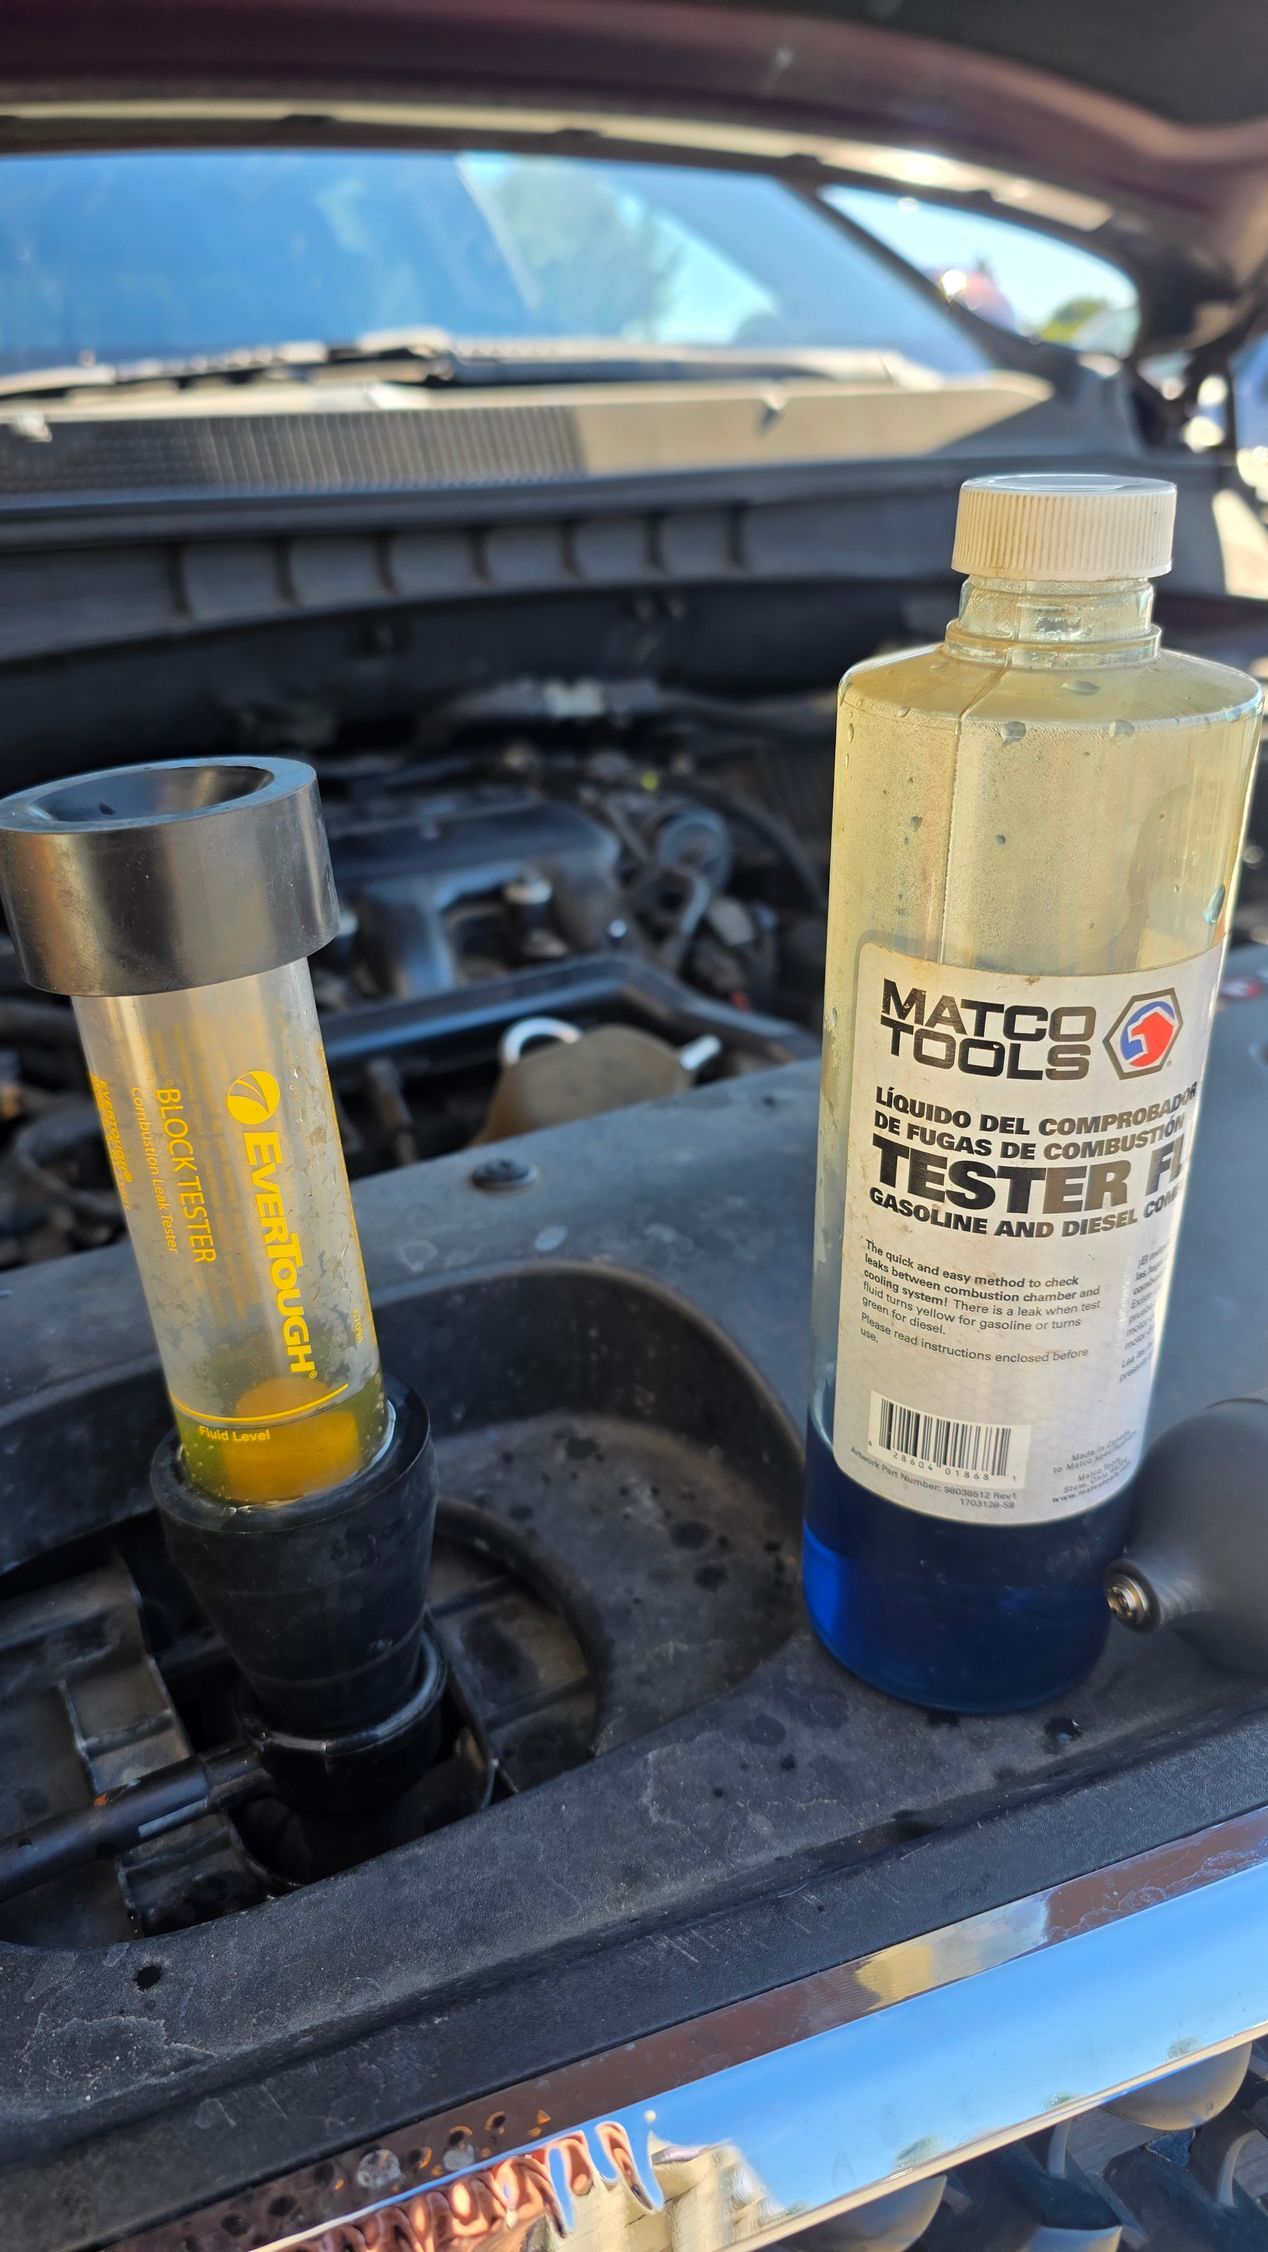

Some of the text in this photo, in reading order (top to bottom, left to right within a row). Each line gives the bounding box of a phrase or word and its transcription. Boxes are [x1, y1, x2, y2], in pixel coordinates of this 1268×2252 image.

[882, 978, 1097, 1042] MATCO
[880, 1016, 1091, 1081] TOOLS
[876, 1081, 1198, 1136] LÍQUIDO DEL COMPROBADOR
[874, 1110, 1185, 1160] DE FUGAS DE COMBUSTIÓN
[131, 1087, 178, 1254] Combustion Leak Tester
[155, 1088, 217, 1264] BLOCK TESTER
[872, 1133, 1132, 1214] TESTER
[869, 1186, 987, 1234] GASOLINE
[994, 1221, 1053, 1238] AND
[1062, 1210, 1137, 1238] DIESEL
[865, 1253, 1100, 1302] leaks between combustion chamber and
[866, 1239, 1079, 1288] The quick and easy method to check
[862, 1296, 946, 1335] green for diesel.
[863, 1281, 1082, 1330] fluid turns yellow for gasoline or turns
[864, 1269, 1101, 1316] cooling system! There is a leak when test
[860, 1327, 879, 1343] use.
[861, 1312, 1088, 1363] Please read instructions enclosed before
[199, 1425, 271, 1441] Fluid Level
[851, 1446, 880, 1470] Artwork
[882, 1464, 898, 1478] Part
[900, 1473, 941, 1491] Number:
